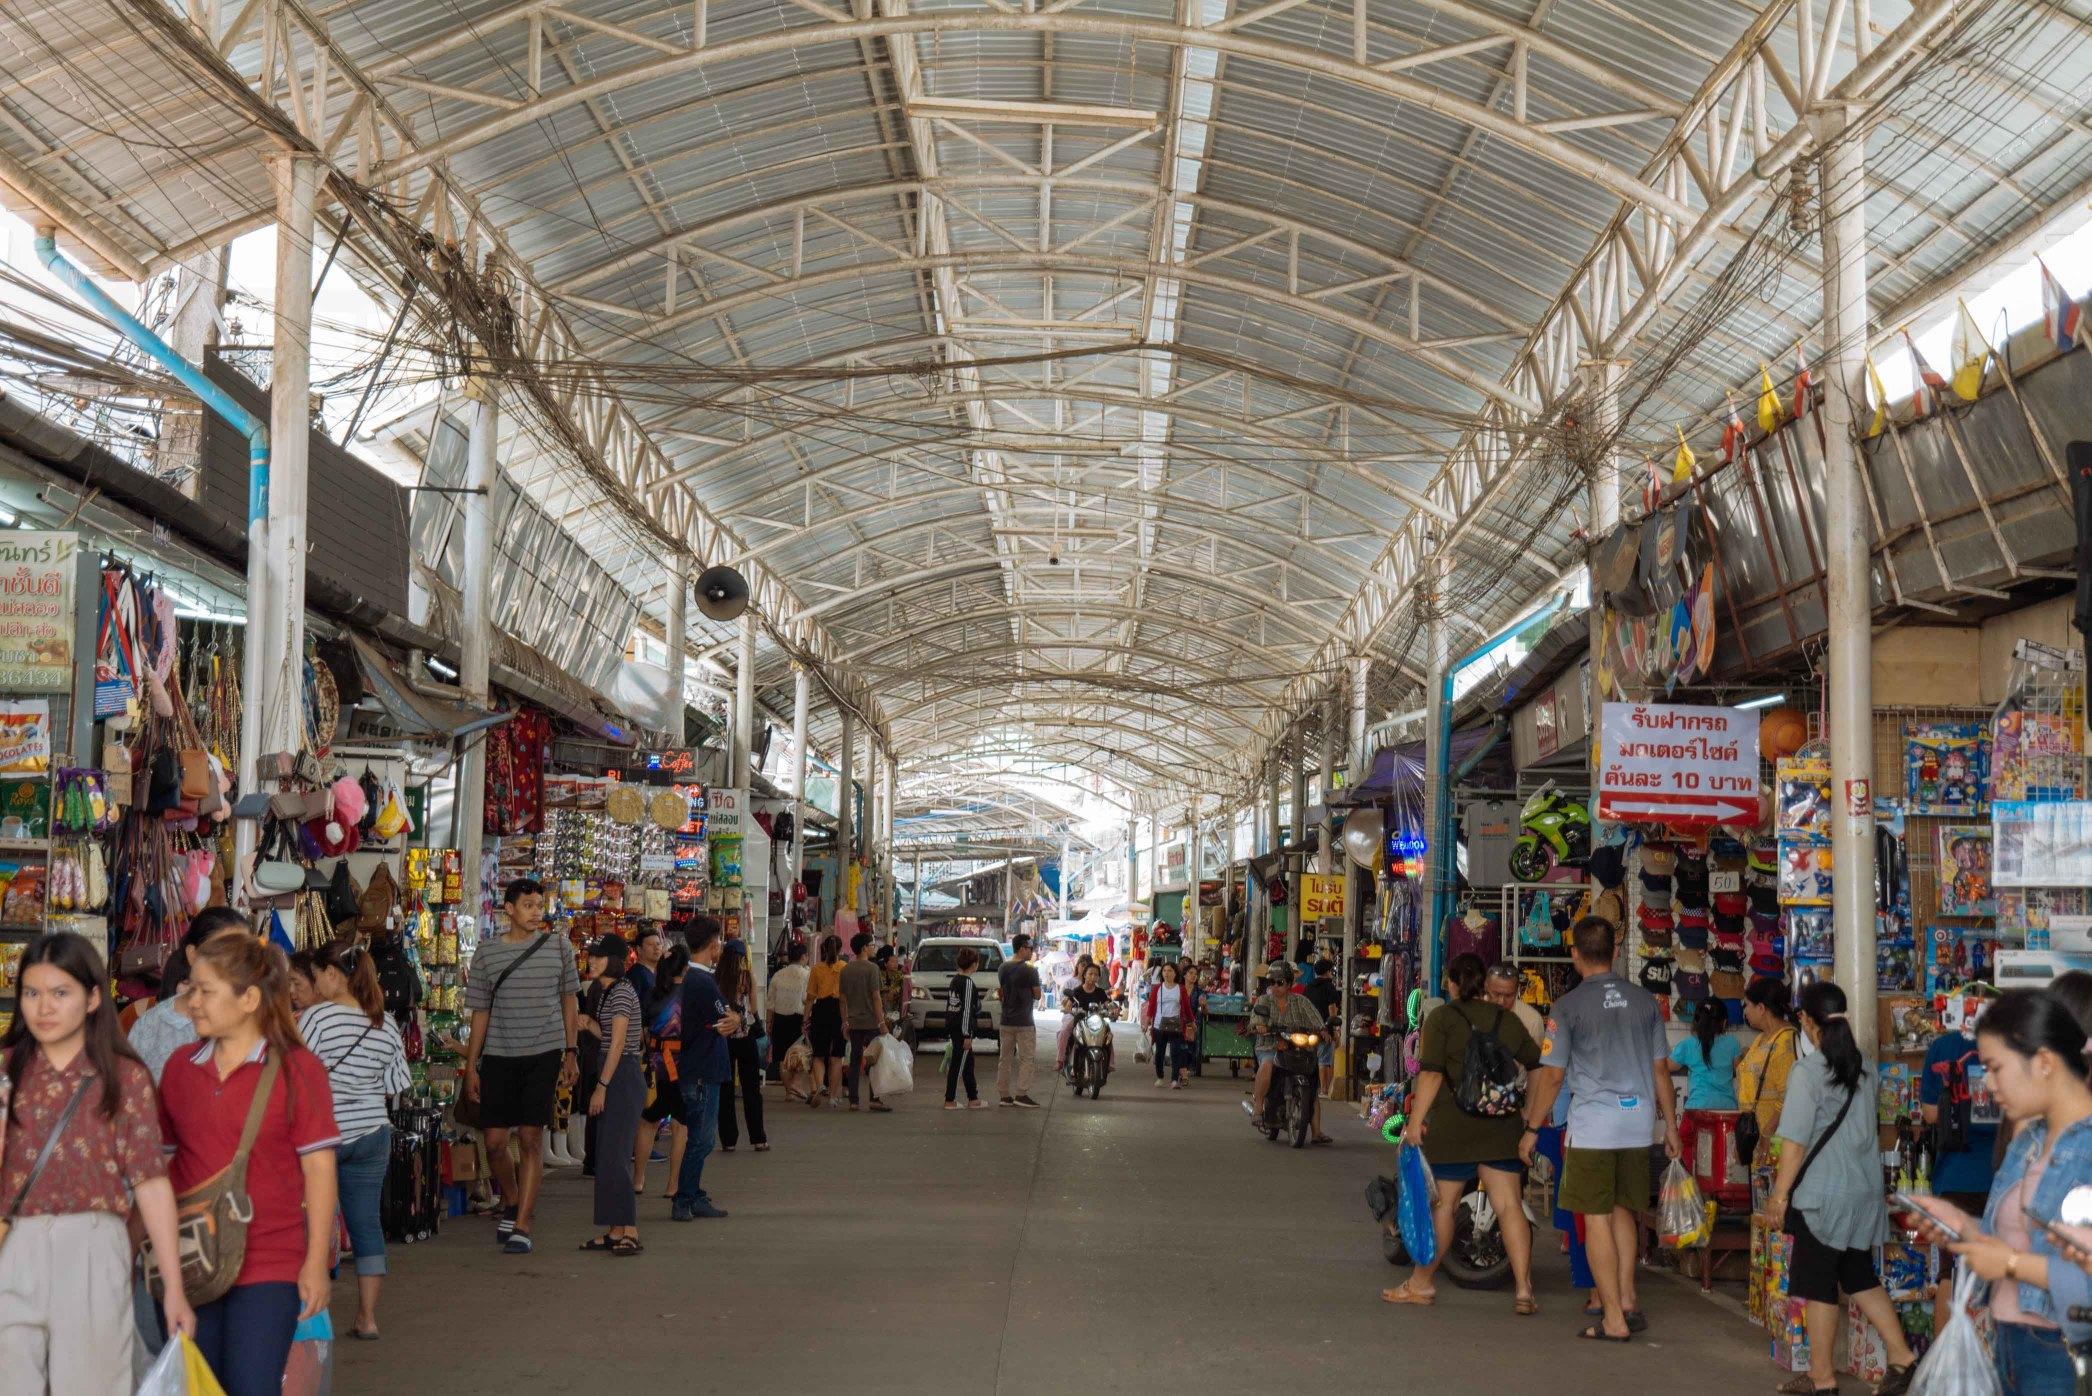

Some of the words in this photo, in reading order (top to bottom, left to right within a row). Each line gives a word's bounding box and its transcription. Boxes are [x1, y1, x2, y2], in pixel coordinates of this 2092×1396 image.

[1632, 706, 1728, 732] รับฝากรถ
[1619, 737, 1738, 761] มอเตอร์ไซค์
[1604, 764, 1662, 787] คันละ
[1672, 772, 1700, 789] 10
[1708, 775, 1752, 791] บาท
[1714, 876, 1732, 889] 50
[1603, 999, 1628, 1009] Chang
